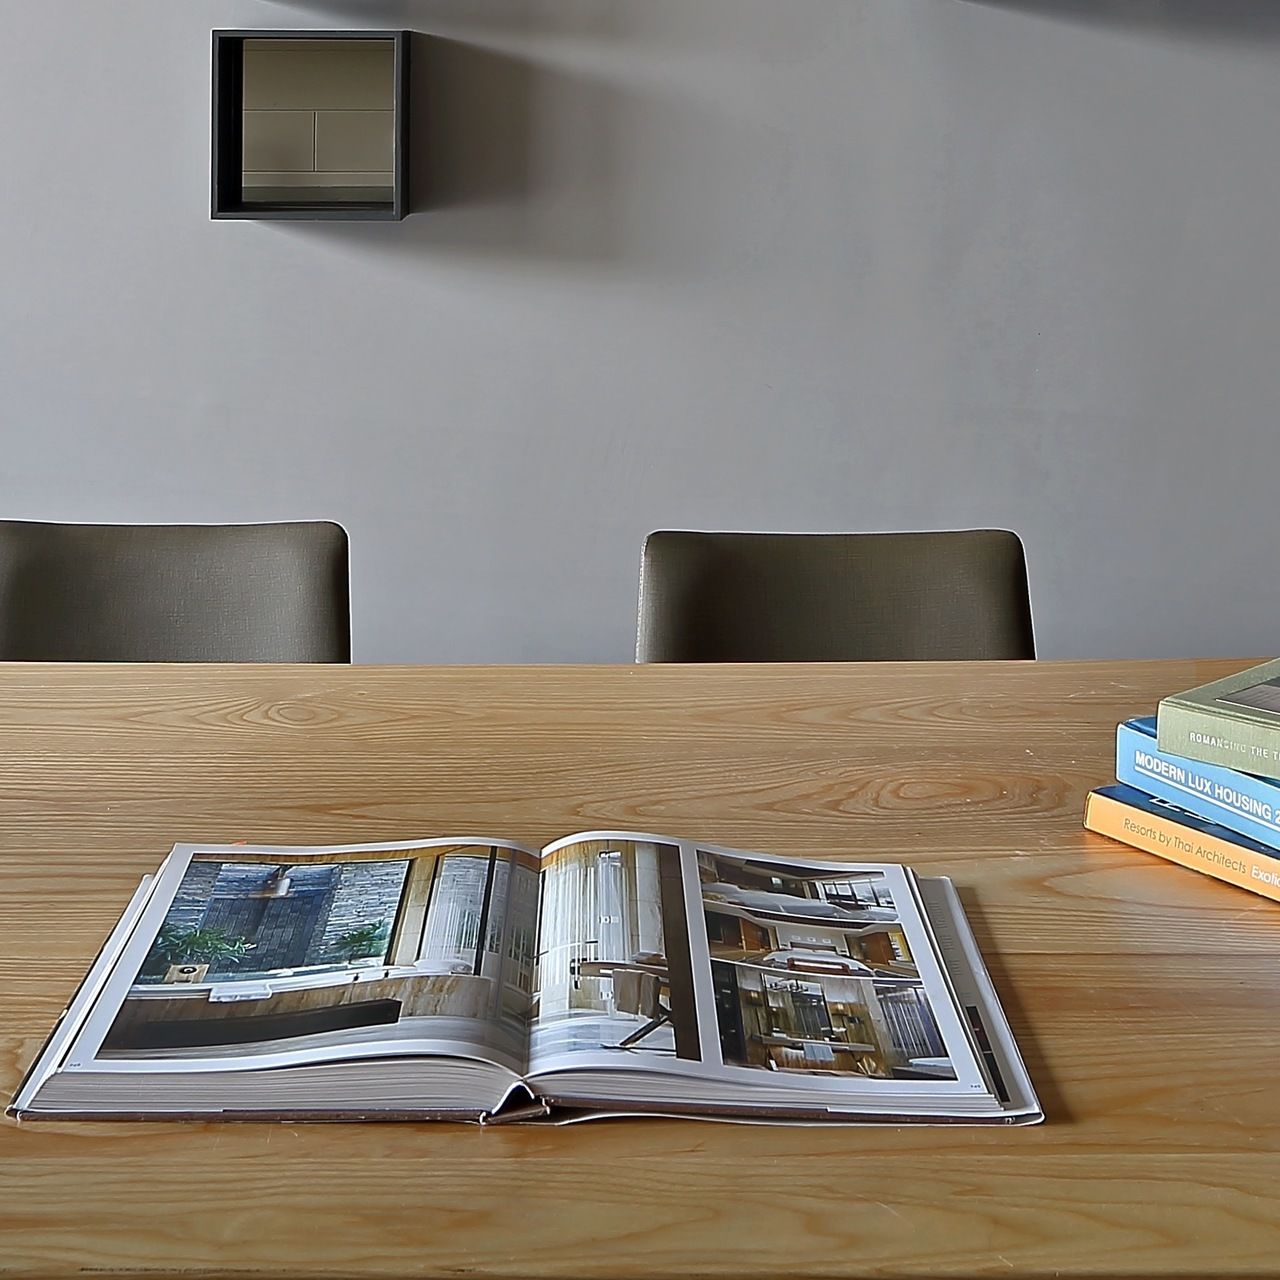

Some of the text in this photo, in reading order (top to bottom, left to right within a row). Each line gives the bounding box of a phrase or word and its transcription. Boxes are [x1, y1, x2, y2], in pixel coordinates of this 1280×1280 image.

[1250, 746, 1269, 758] THE
[1135, 750, 1185, 783] MODERN
[1188, 773, 1213, 795] LUX
[1215, 783, 1272, 819] HOUSING
[1123, 818, 1157, 840] Resorts
[1159, 832, 1173, 847] by
[1174, 836, 1194, 853] Thai
[1195, 845, 1247, 874] Architects
